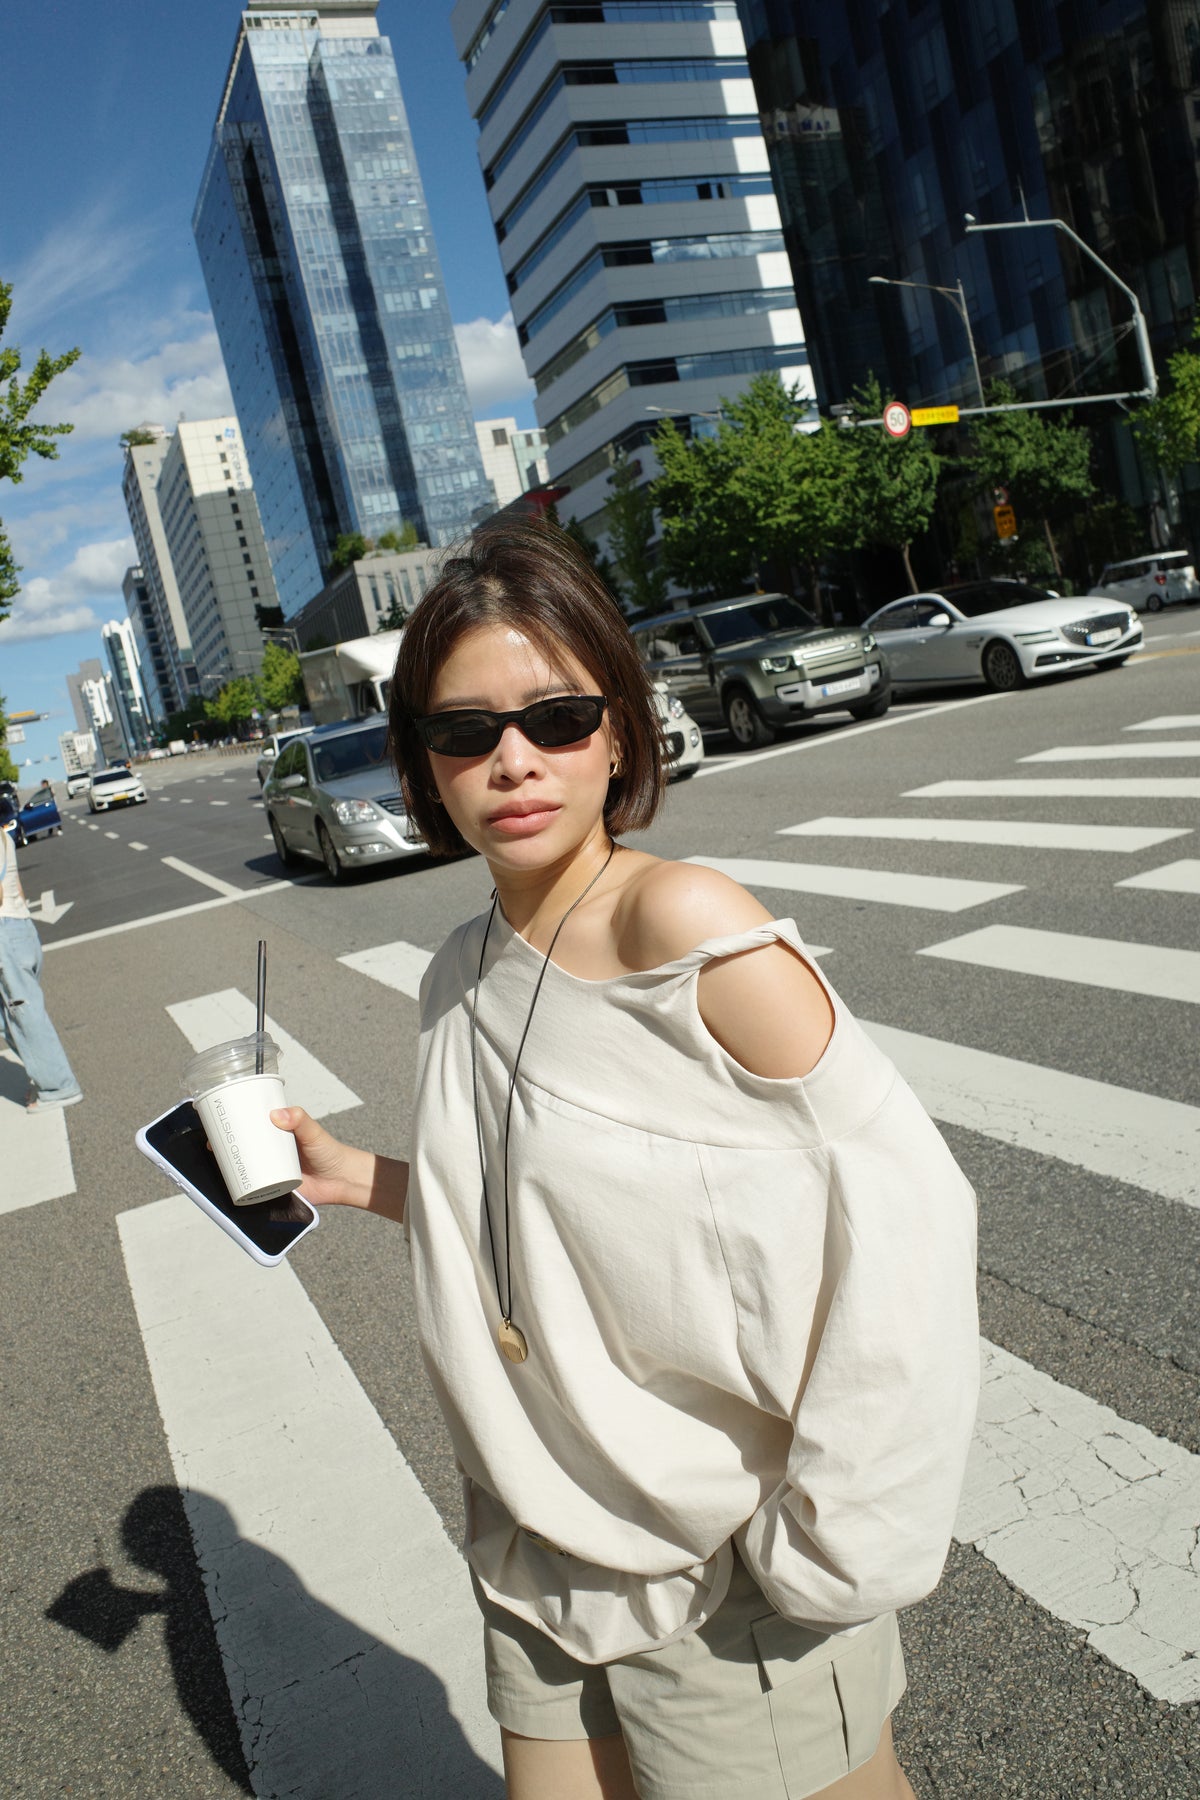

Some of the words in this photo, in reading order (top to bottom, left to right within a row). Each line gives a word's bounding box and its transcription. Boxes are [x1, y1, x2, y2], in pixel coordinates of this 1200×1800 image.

[890, 411, 905, 427] 50
[214, 1098, 235, 1144] SYSTEM
[230, 1144, 252, 1190] STANDARD
